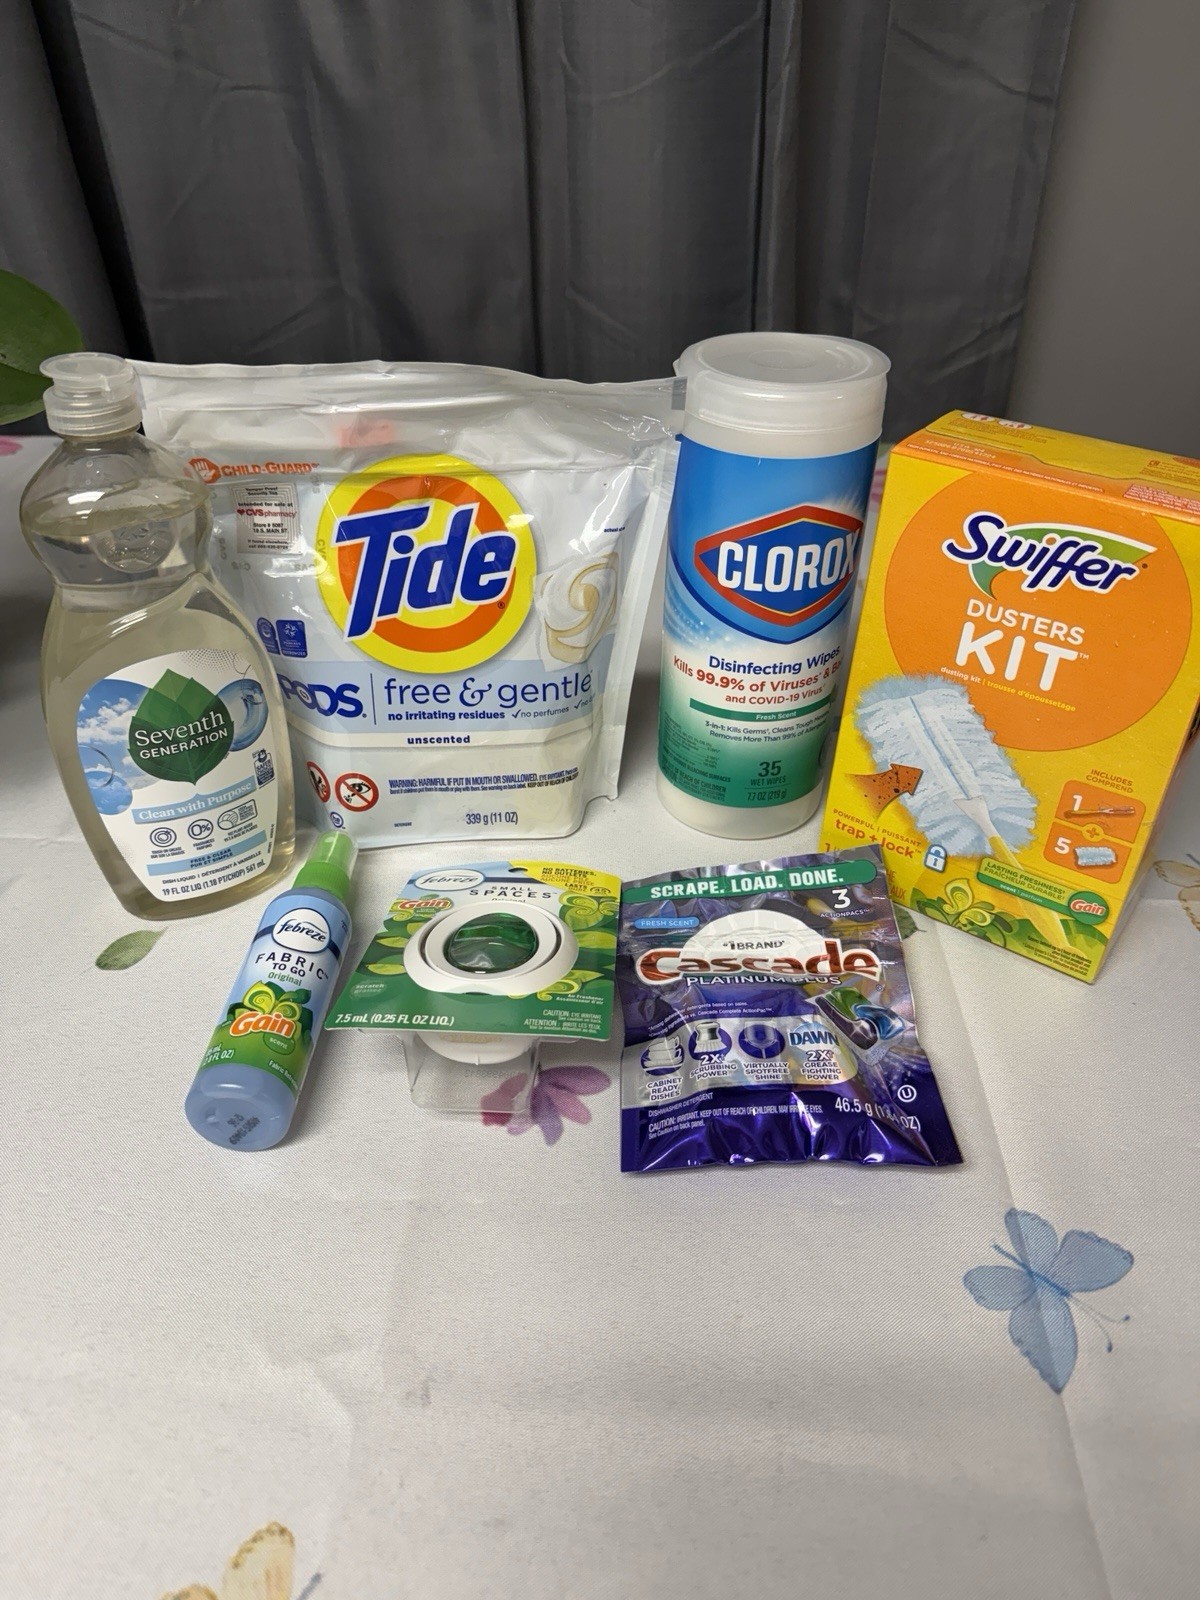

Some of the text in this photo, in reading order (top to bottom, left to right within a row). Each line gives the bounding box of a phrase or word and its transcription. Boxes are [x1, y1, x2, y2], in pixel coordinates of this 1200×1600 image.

[718, 527, 860, 592] CLOROX
[946, 514, 1137, 590] Swiffer
[333, 503, 518, 639] Tide
[966, 599, 1085, 645] DUSTERS
[709, 656, 802, 675] Disinfecting
[806, 646, 840, 669] Wipes
[674, 656, 693, 677] Kills
[697, 669, 745, 691] 99.9%
[750, 680, 766, 691] of
[823, 668, 830, 677] &
[384, 672, 591, 708] free & gentle
[941, 666, 1076, 712] dusting kit trousse d'époussetage
[725, 694, 746, 704] and
[749, 694, 800, 704] COVID-19
[405, 710, 455, 722] irritating
[458, 710, 505, 720] residues
[534, 706, 569, 719] perfumes
[778, 711, 796, 719] Scent
[135, 711, 225, 747] Seventh
[705, 720, 726, 731] 3-in-1:
[772, 725, 794, 734] Cleans
[796, 720, 814, 730] Tough
[140, 728, 228, 759] GENERATION
[408, 735, 470, 744] unscented
[710, 730, 742, 742] Removes
[782, 732, 796, 740] 99%
[758, 760, 781, 777] 35
[419, 778, 446, 786] HARMFUL
[453, 778, 464, 786] PUT
[465, 777, 471, 785] IN
[472, 776, 492, 785] MOUTH
[493, 776, 501, 784] OR
[502, 773, 538, 784] SWALLOWED.
[751, 776, 786, 786] WET WIPES
[1086, 775, 1133, 793] COMPREND
[1091, 769, 1133, 786] INCLUDES
[138, 782, 252, 821] Clean with Purpose
[758, 792, 766, 800] OZ
[1073, 795, 1082, 811] 1
[466, 812, 518, 825] 339 g (11 OZ)
[191, 823, 211, 837] 0%
[833, 809, 922, 847] POWERFUL PUISSANT
[835, 819, 865, 840] trap
[1054, 837, 1071, 854] 5
[162, 859, 266, 896] 19 FL OZ LIQ (1.18 PT/CHOP) 561 mL
[986, 862, 1018, 877] LASTING
[421, 874, 478, 885] febreze
[650, 868, 844, 899] SCRAPE. LOAD. DONE.
[400, 899, 448, 909] Gain
[832, 889, 850, 909] 3
[1070, 900, 1105, 915] Gain
[276, 919, 327, 944] febreze
[273, 962, 306, 977] TO GO
[639, 941, 879, 982] Cascade
[268, 972, 302, 986] Original
[686, 975, 785, 987] PLATINUM
[230, 1011, 296, 1038] Gain
[335, 1013, 454, 1026] 7.5 mL (0.25 FL OZ LIQ.)
[269, 1036, 289, 1050] scent
[789, 1030, 840, 1046] DAWN
[690, 1064, 736, 1077] SCRUBBING
[697, 1071, 727, 1080] POWER
[648, 1078, 682, 1088] CABINET
[652, 1085, 678, 1094] READY
[651, 1091, 680, 1100] DISHES
[648, 1092, 713, 1118] DISHWASHER DETERGENT
[649, 1118, 676, 1132] CAUTION:
[700, 1110, 712, 1118] KEEP
[713, 1108, 722, 1116] OUT
[730, 1107, 746, 1115] REACH
[779, 1105, 789, 1113] MAY
[810, 1105, 823, 1113] EYES.
[835, 1097, 921, 1132] 46.5 g OZ)
[657, 1126, 673, 1136] Caution
[679, 1122, 690, 1130] back
[691, 1119, 705, 1129] panel.
